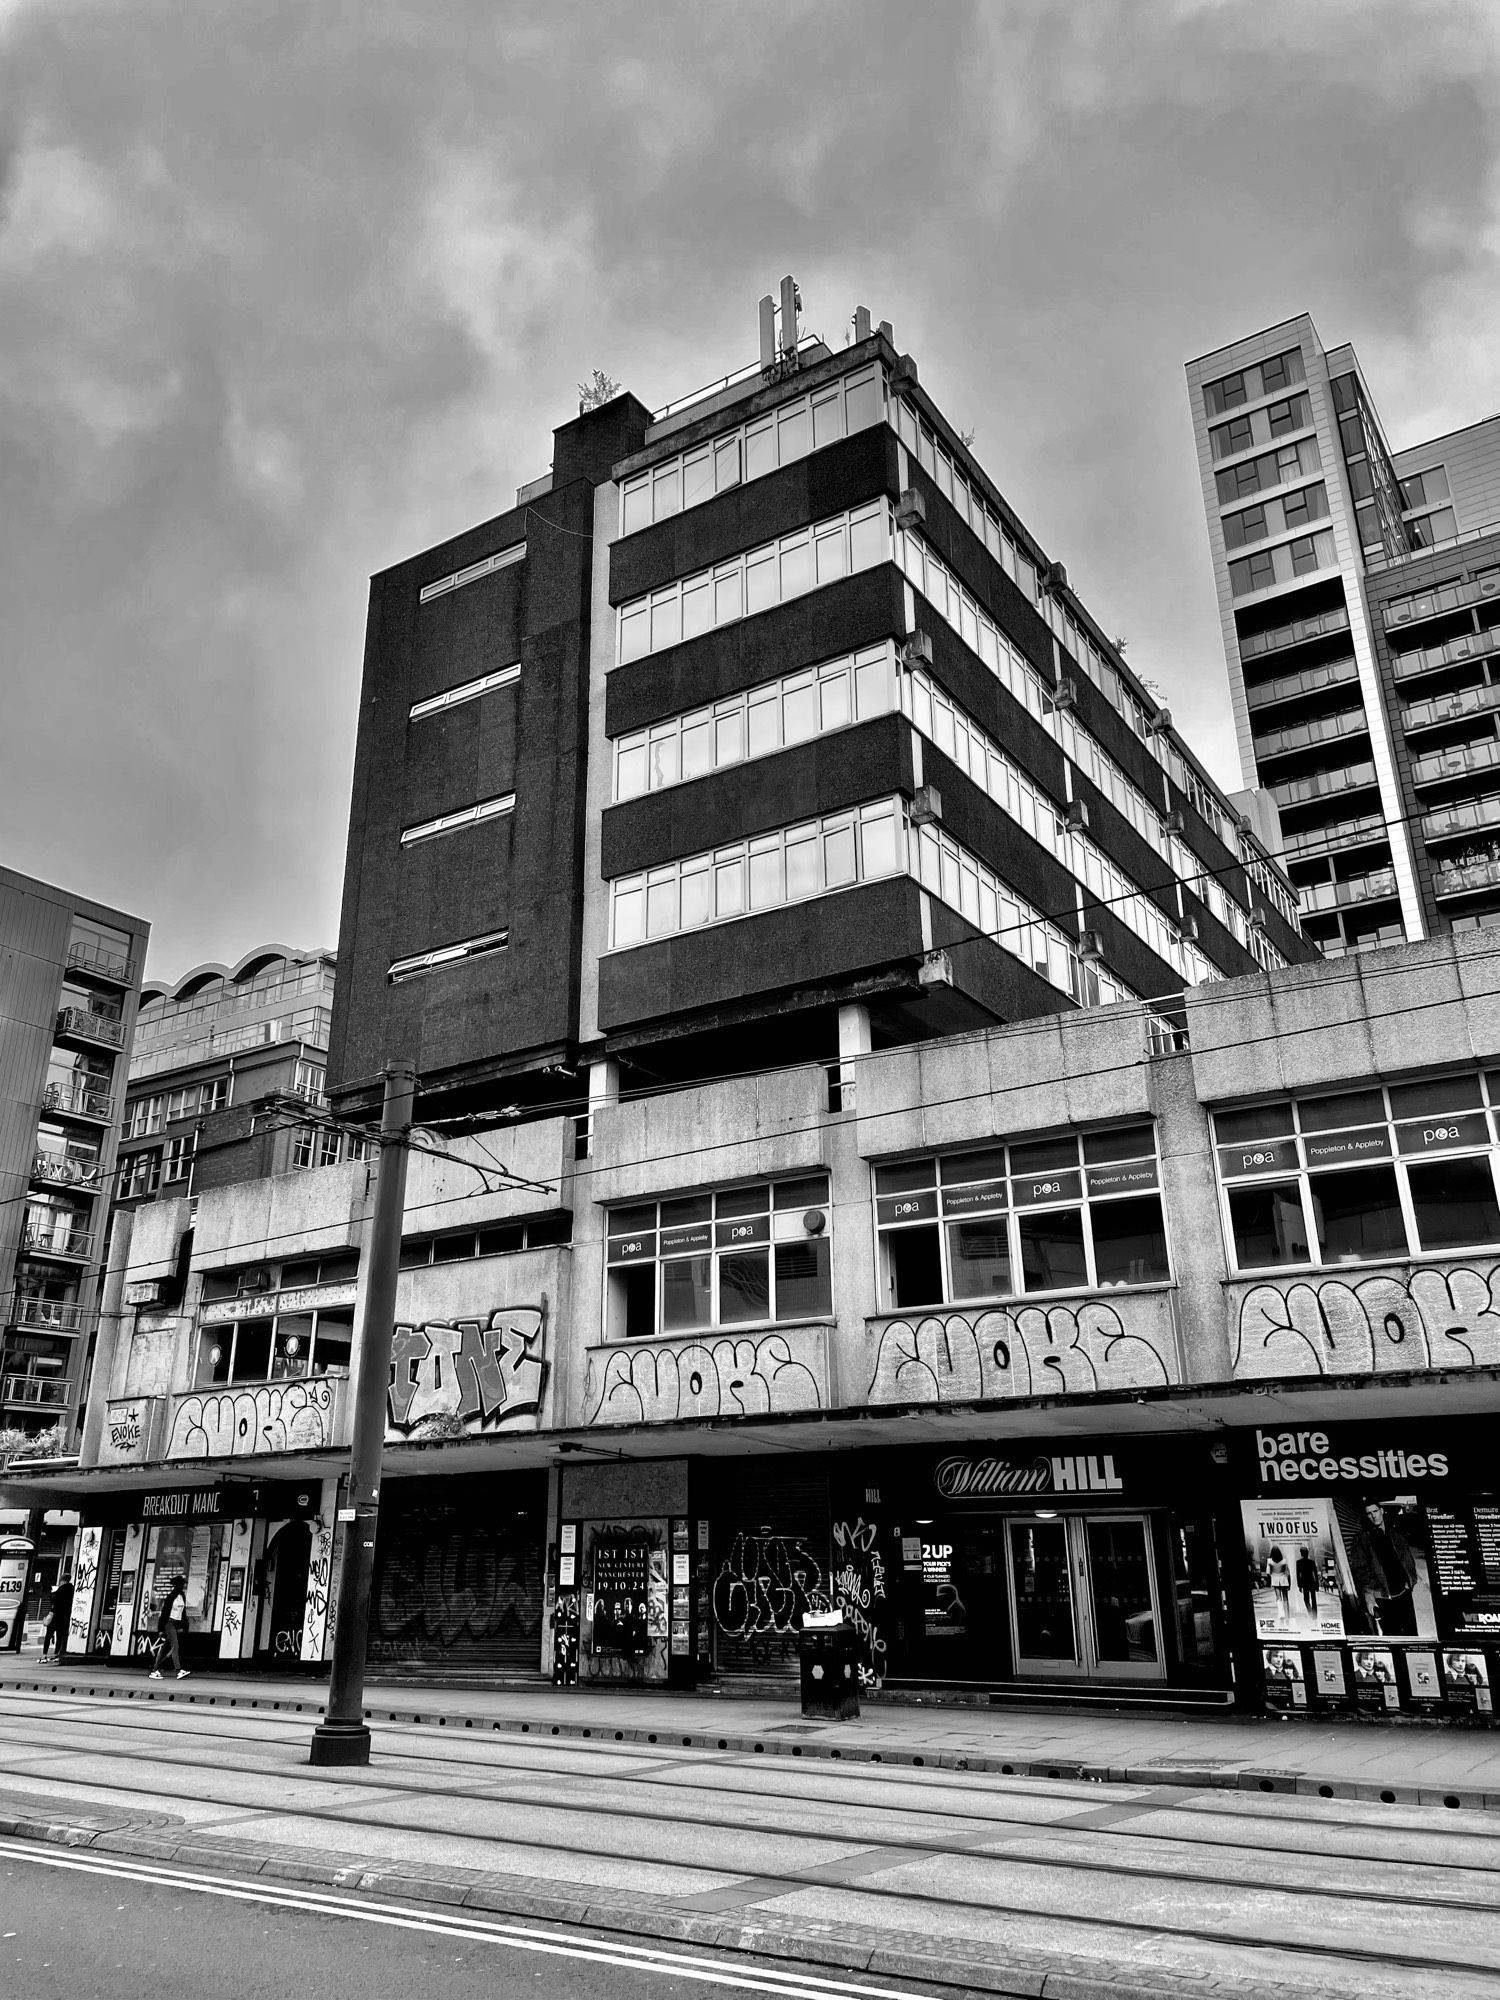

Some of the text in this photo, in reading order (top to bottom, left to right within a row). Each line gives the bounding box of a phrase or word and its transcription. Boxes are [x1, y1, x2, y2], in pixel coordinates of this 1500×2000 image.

[1310, 1138, 1384, 1155] Poppleton & Appleby
[1090, 1175, 1121, 1186] Poppleton
[1128, 1170, 1154, 1182] Appleby
[946, 1195, 973, 1205] Poppleton
[980, 1192, 1003, 1203] Appleby
[663, 1237, 685, 1246] Poppleton
[690, 1233, 708, 1243] Appleby
[111, 1424, 141, 1443] EVOKE
[1255, 1429, 1330, 1459] bare
[1258, 1449, 1449, 1482] necessities
[935, 1455, 1122, 1499] William HILL
[143, 1491, 221, 1517] BREAKOUT MANC
[1258, 1521, 1318, 1539] TWO OF US
[598, 1581, 644, 1591] 19.10.24
